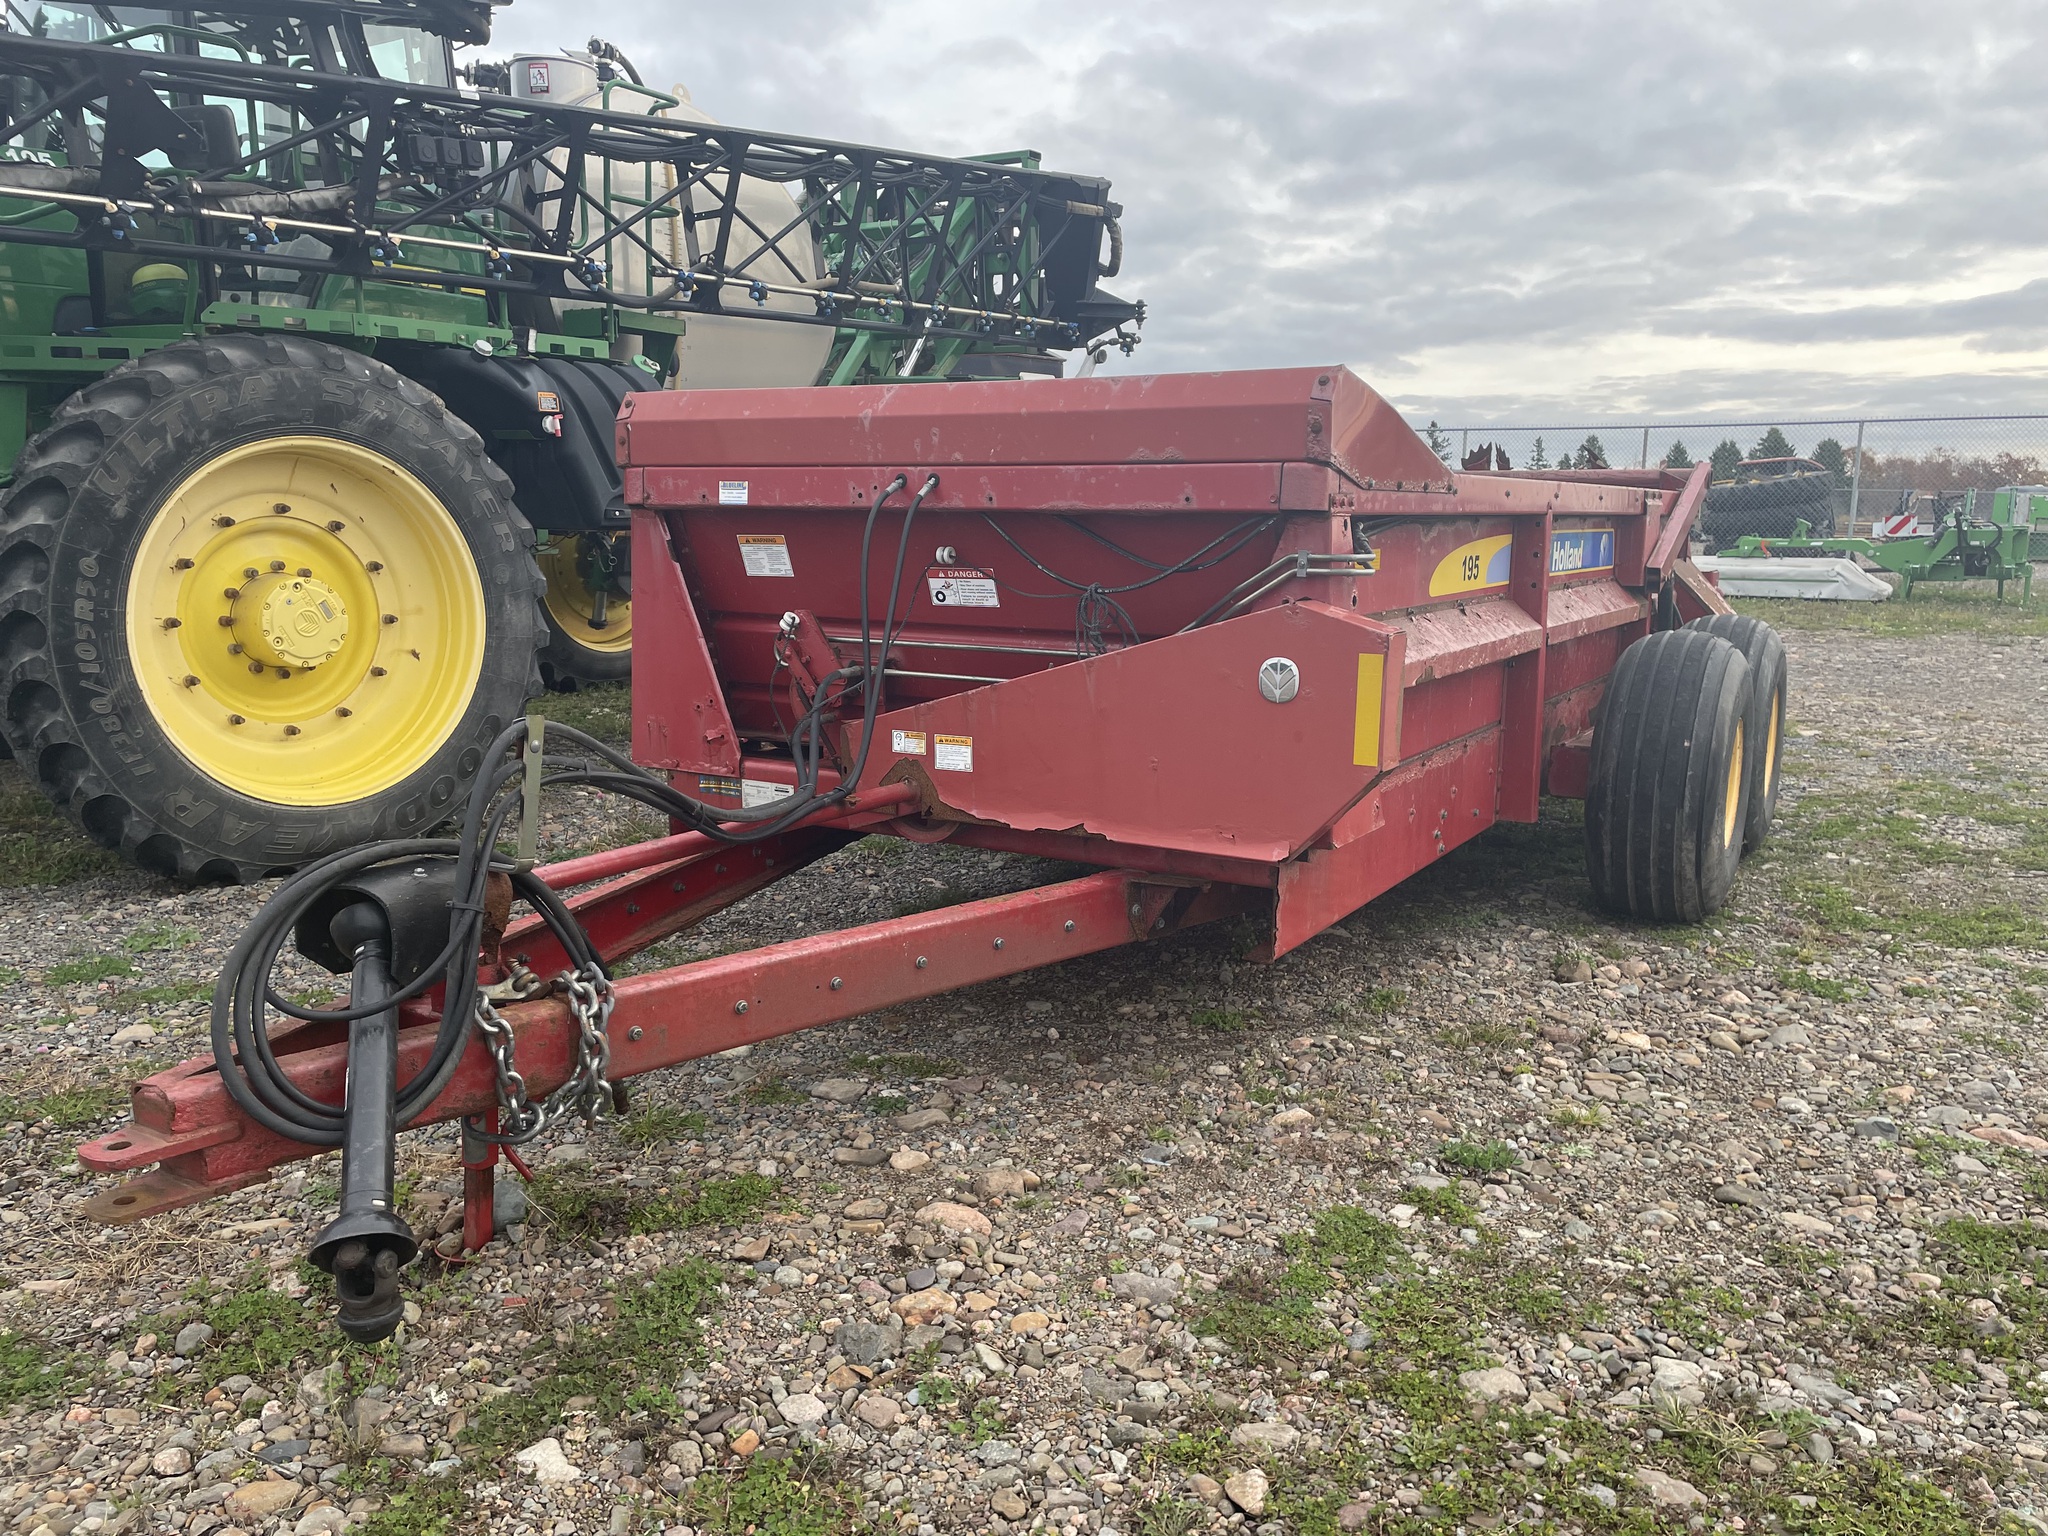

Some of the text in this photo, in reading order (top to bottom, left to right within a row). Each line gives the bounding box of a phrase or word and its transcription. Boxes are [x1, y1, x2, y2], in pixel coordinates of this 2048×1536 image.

[94, 376, 515, 552] ULTRA SPRAYER
[1462, 555, 1480, 582] 195
[1552, 540, 1583, 571] Holland
